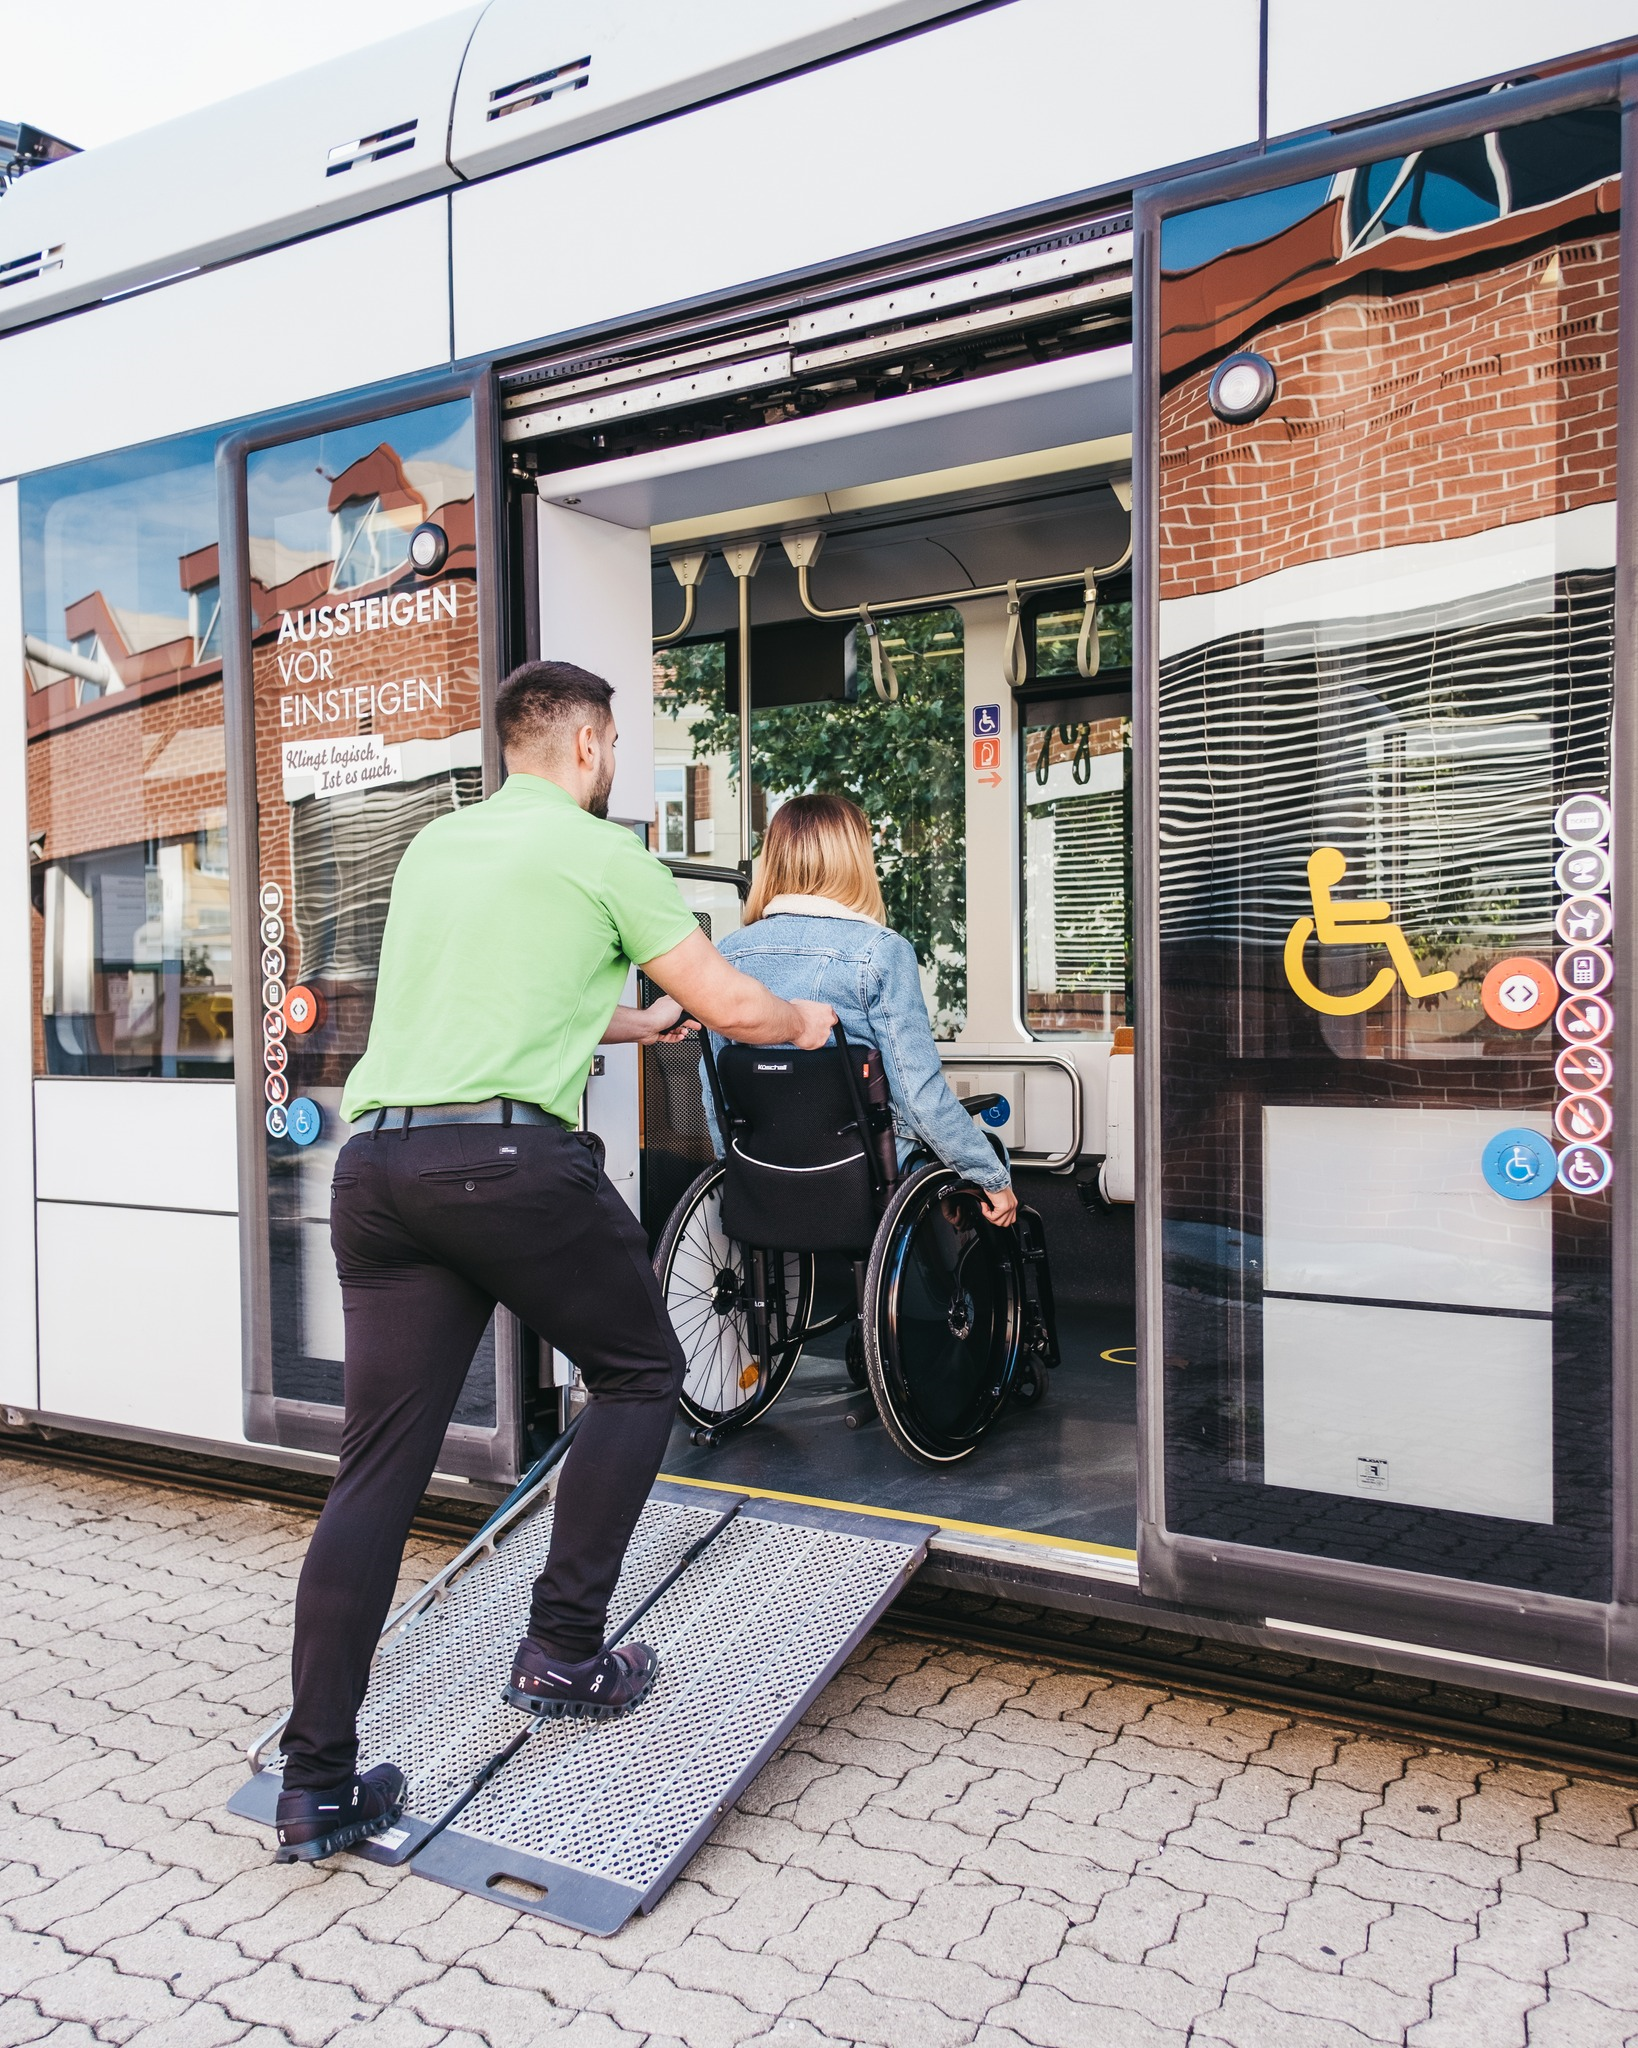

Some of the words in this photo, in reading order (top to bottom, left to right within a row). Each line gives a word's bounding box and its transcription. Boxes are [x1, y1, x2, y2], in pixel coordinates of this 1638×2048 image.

[277, 584, 457, 645] AUSSTEIGEN
[277, 649, 334, 686] VOR
[280, 676, 442, 728] EINSTEIGEN
[286, 748, 328, 771] Klingt
[330, 742, 380, 768] logisch.
[321, 770, 343, 791] Ist
[345, 770, 358, 785] es
[361, 757, 397, 780] auch.
